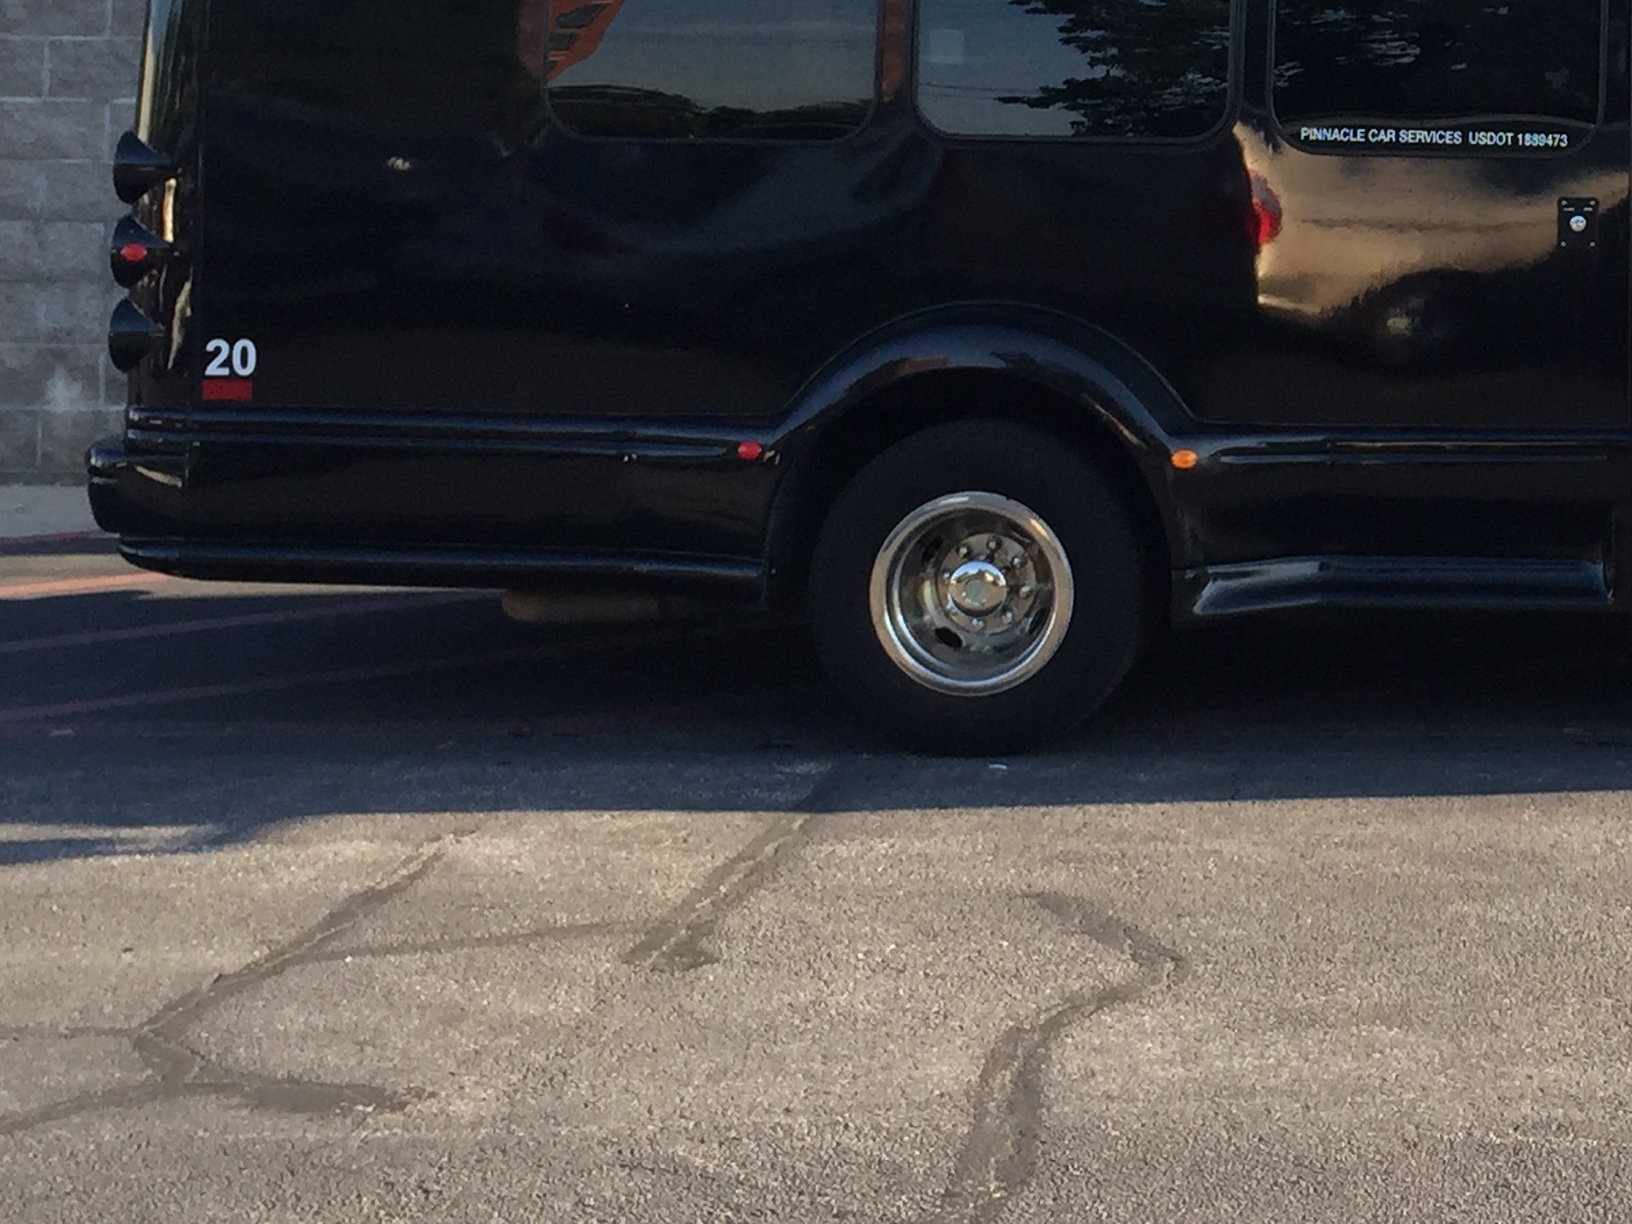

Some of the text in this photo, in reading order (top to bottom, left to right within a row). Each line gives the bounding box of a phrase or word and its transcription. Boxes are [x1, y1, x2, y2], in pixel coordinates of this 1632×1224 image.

[1301, 127, 1366, 142] PINNACLE
[1368, 128, 1396, 143] CAR
[1399, 129, 1463, 144] SERVICES
[1468, 131, 1514, 145] USDOT
[204, 338, 257, 376] 20
